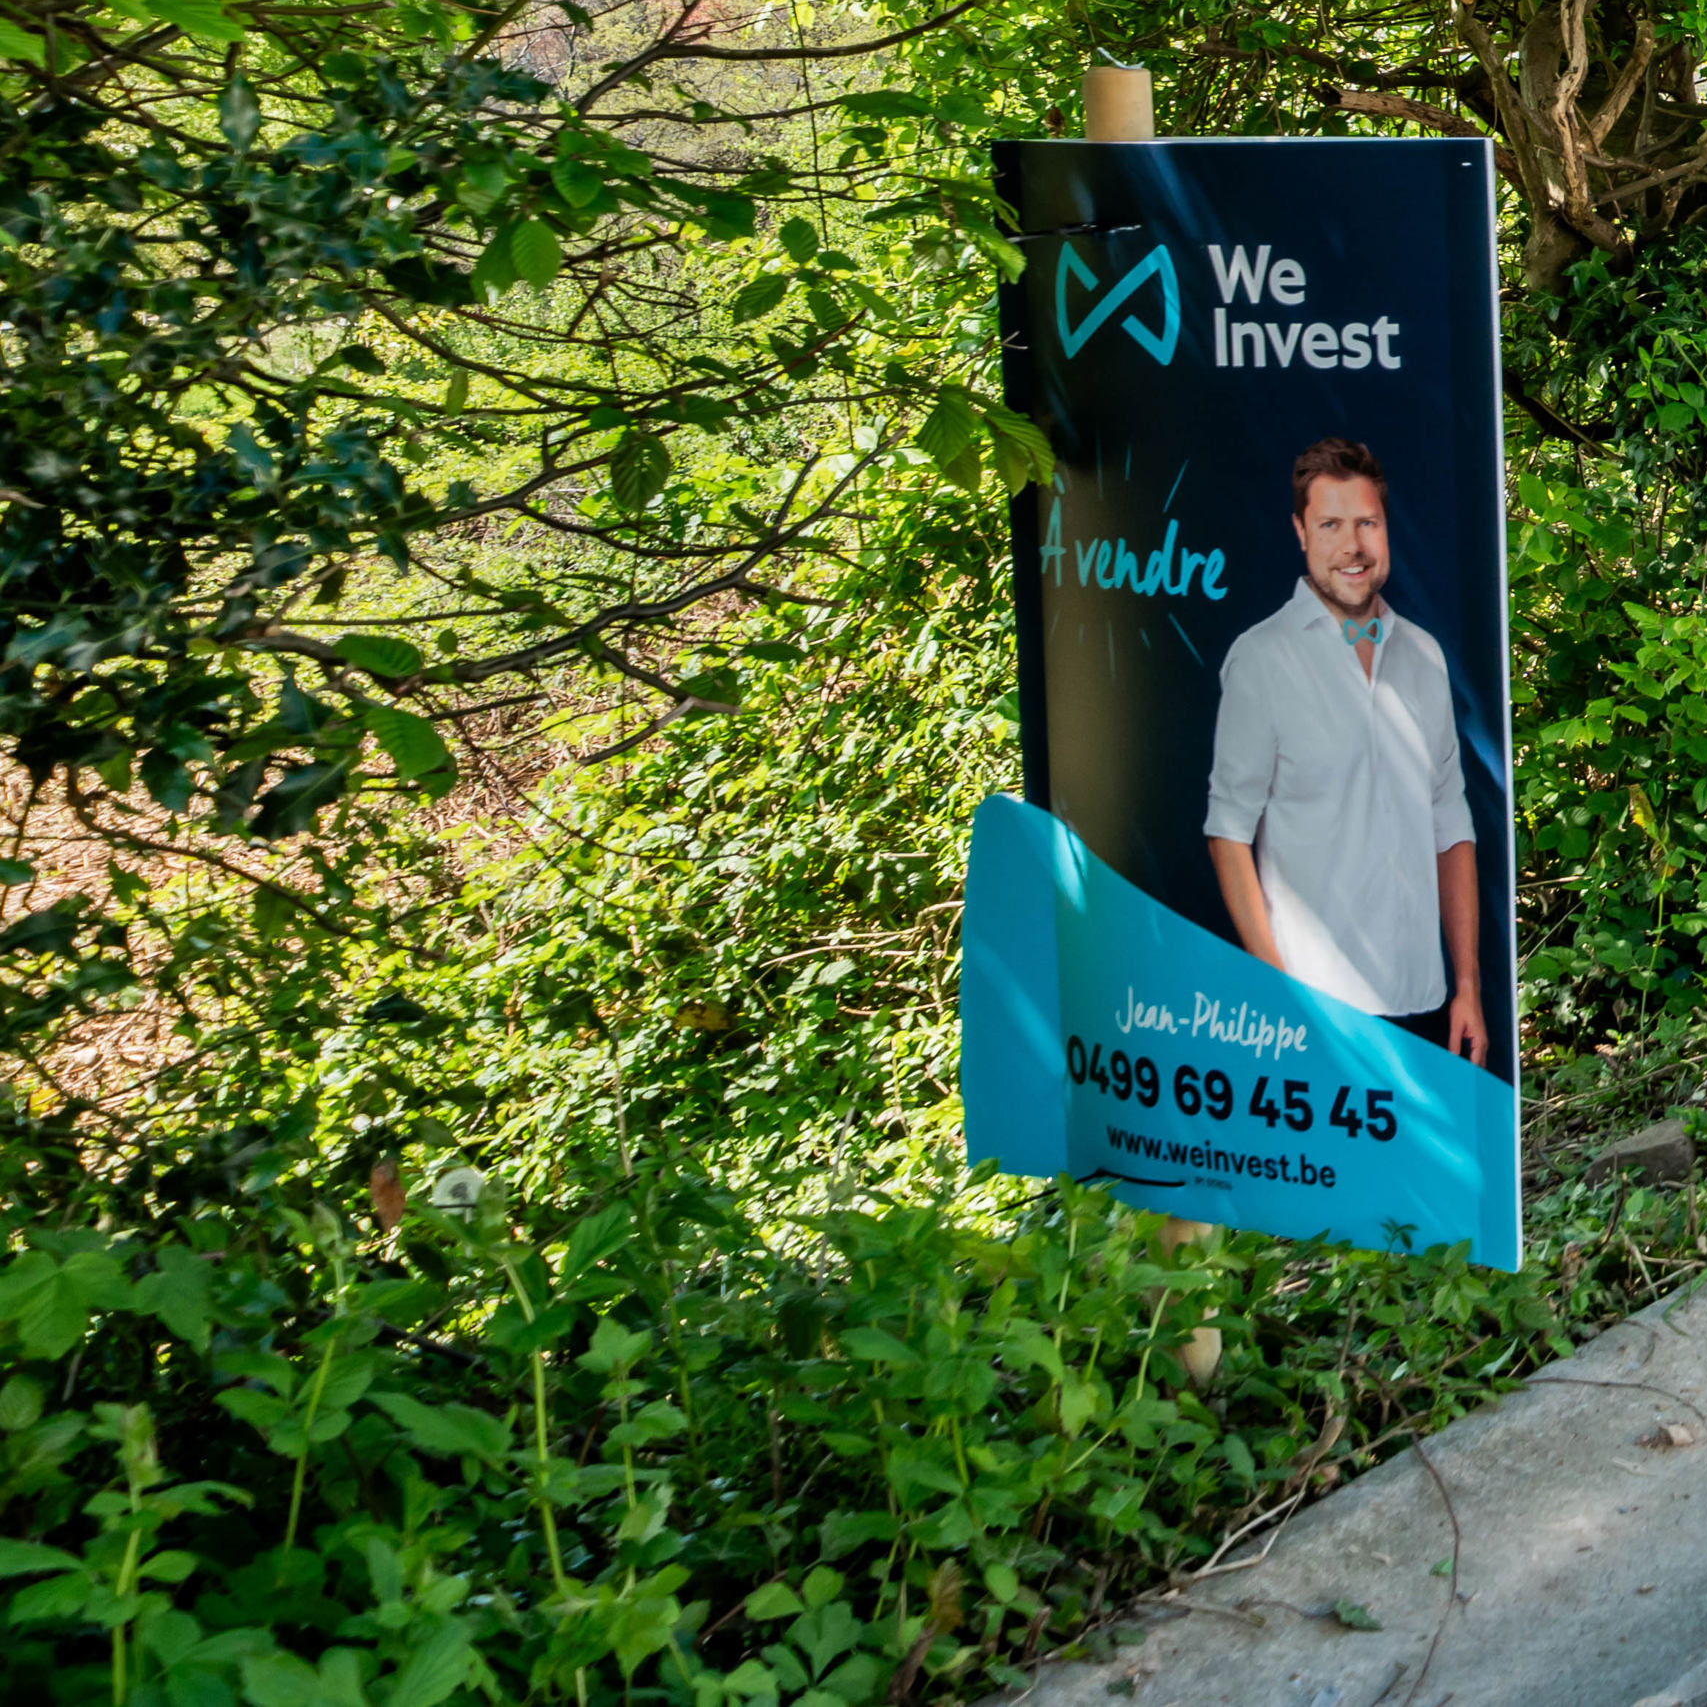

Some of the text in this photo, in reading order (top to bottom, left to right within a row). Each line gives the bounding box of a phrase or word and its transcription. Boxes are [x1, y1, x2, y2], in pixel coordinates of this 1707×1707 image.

[1208, 244, 1306, 305] We
[1214, 307, 1401, 369] Invest
[1074, 518, 1228, 600] vendre
[1115, 986, 1307, 1060] Jean-Philippe
[1067, 1035, 1397, 1142] 0499 69 45 45
[1107, 1125, 1336, 1188] www.weinvest.be
